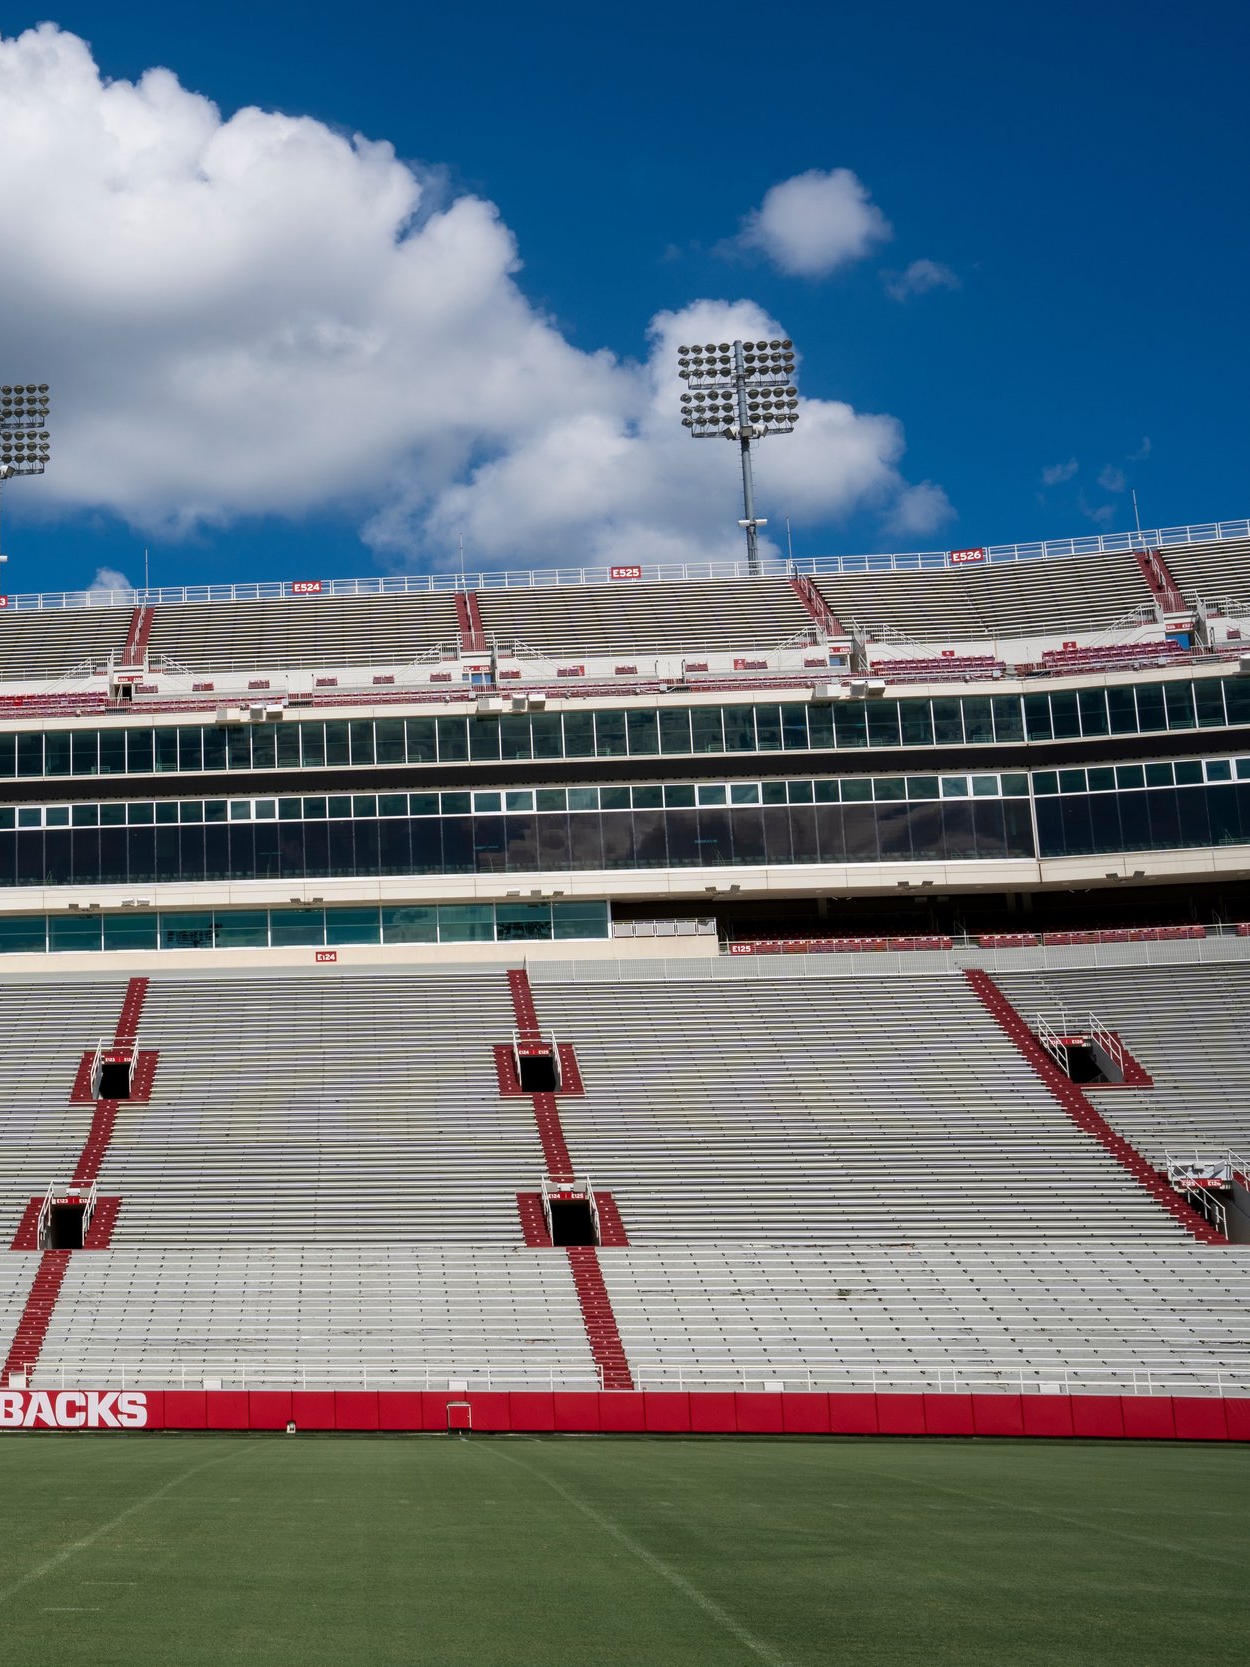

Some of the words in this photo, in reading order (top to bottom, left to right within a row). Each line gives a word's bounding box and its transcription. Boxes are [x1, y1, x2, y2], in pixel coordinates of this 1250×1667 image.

[953, 550, 982, 561] E526
[613, 568, 639, 577] E525
[294, 583, 320, 592] E524
